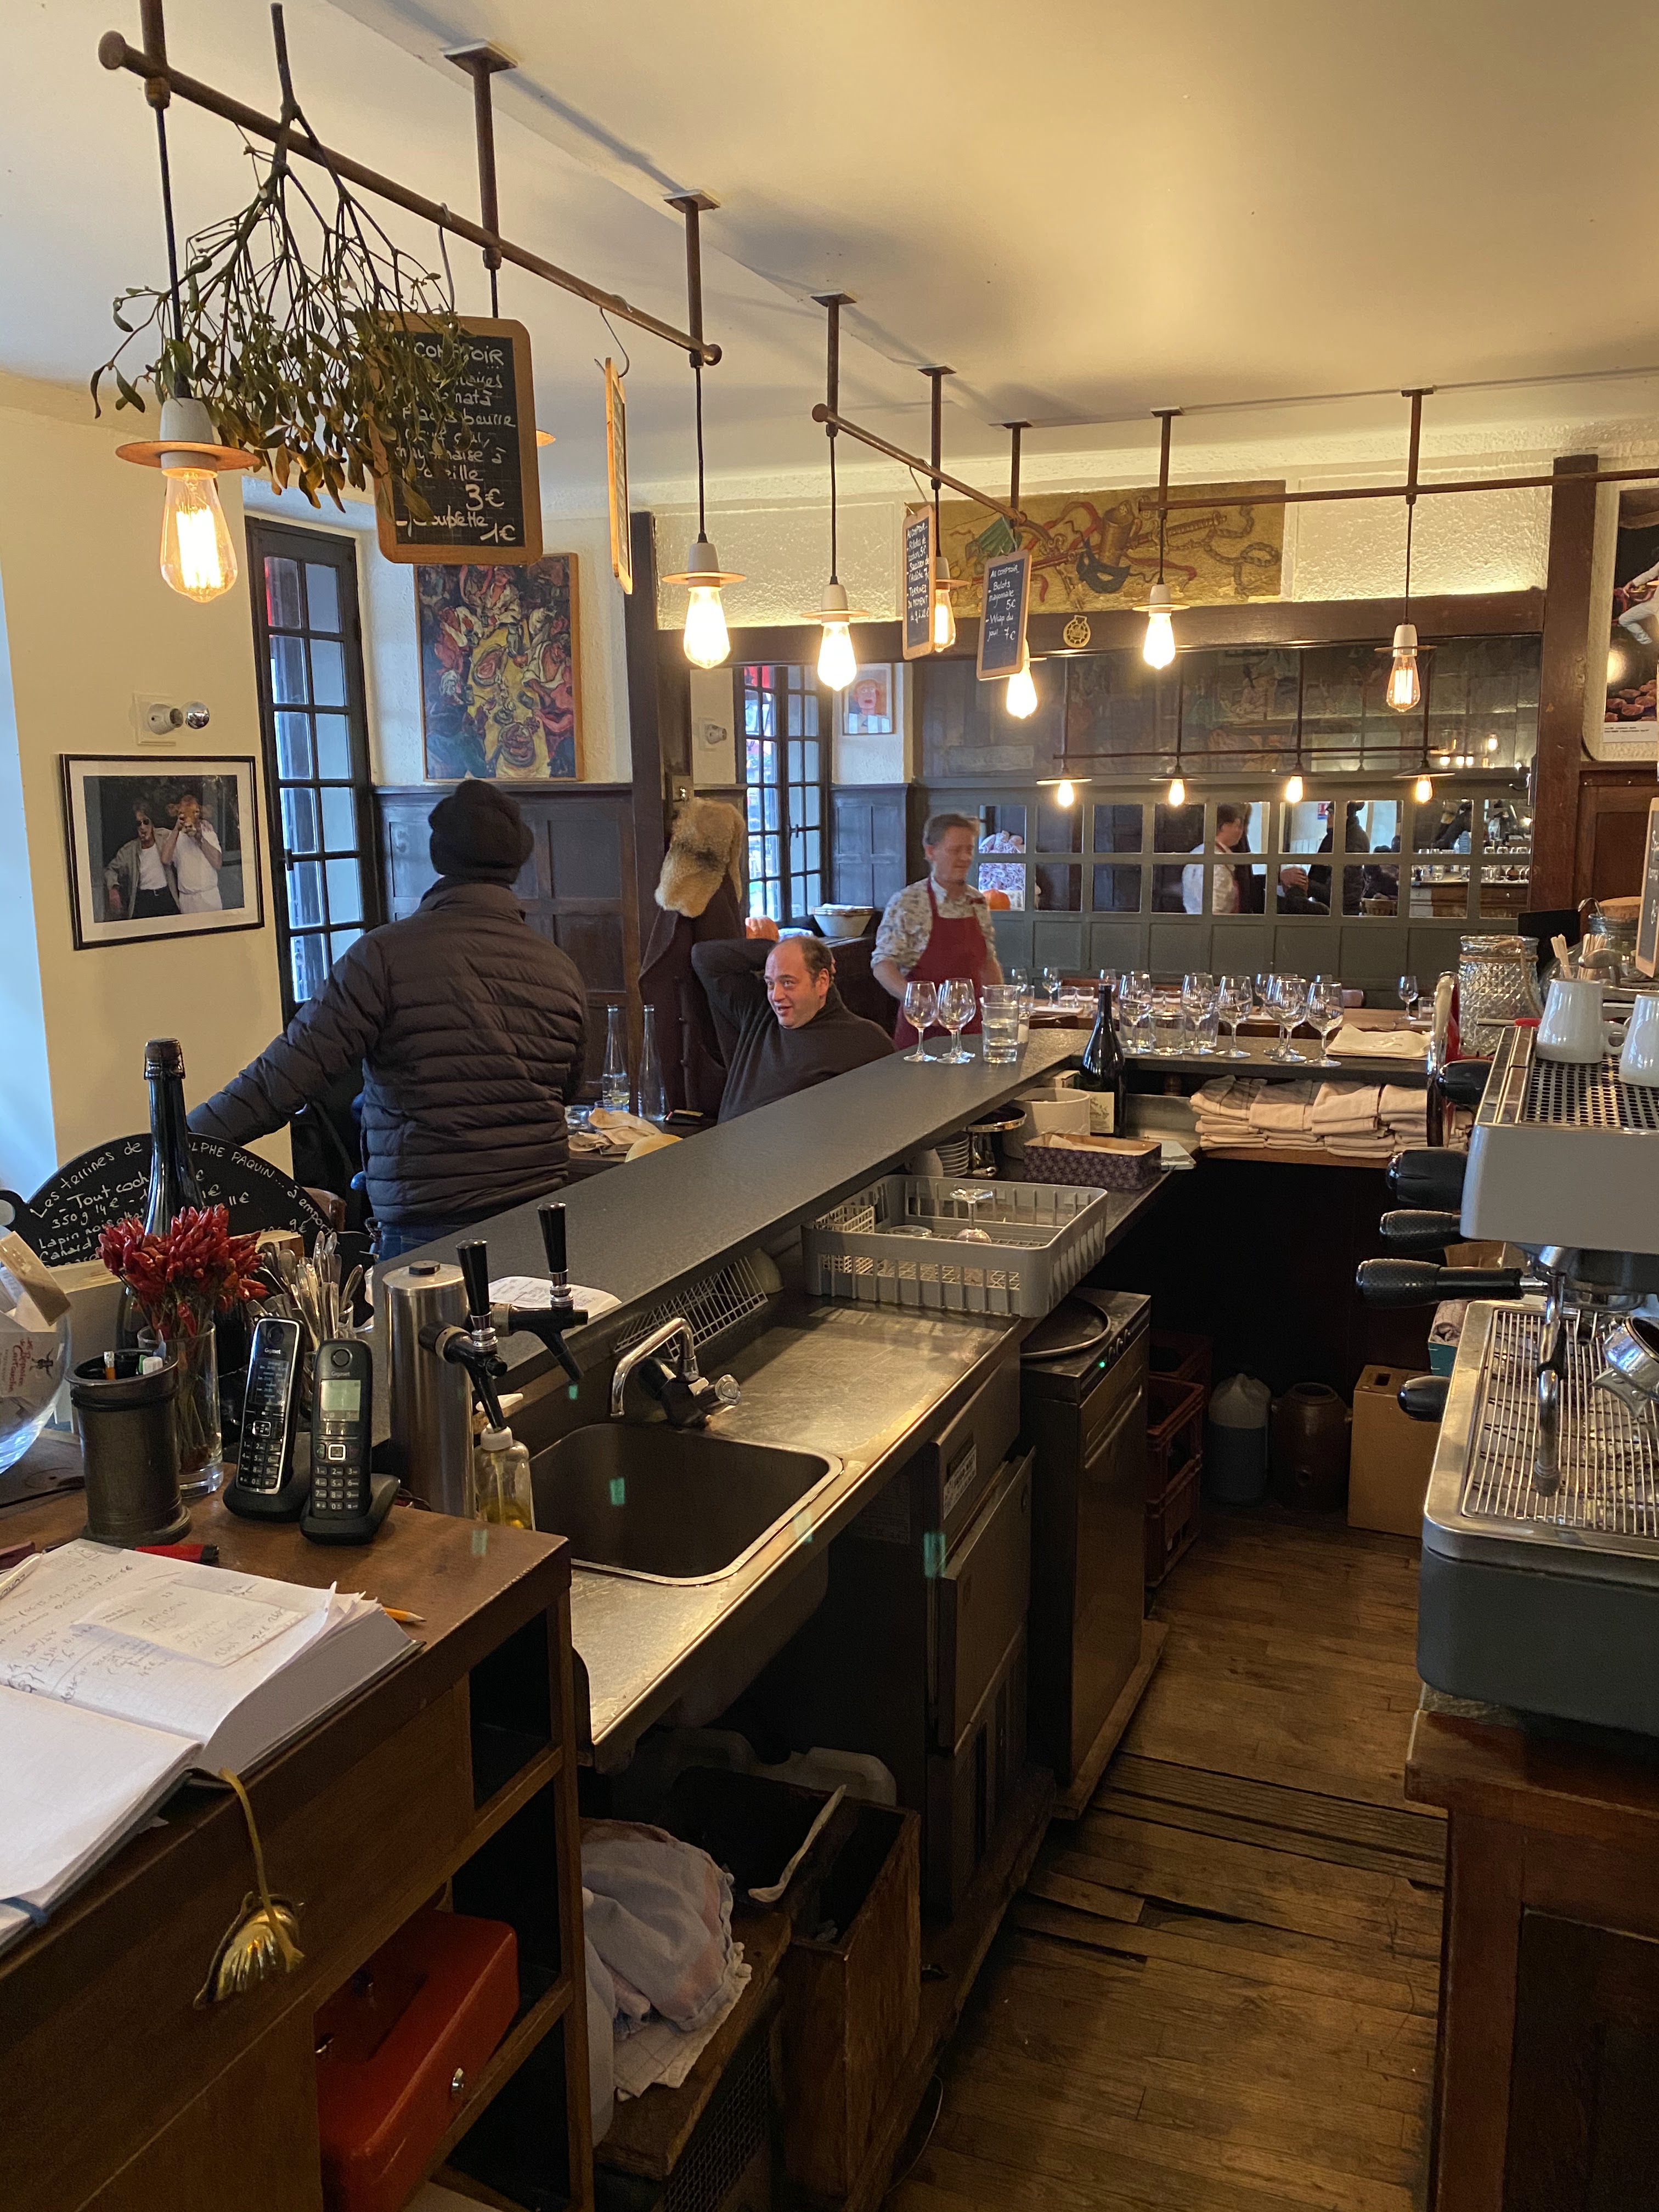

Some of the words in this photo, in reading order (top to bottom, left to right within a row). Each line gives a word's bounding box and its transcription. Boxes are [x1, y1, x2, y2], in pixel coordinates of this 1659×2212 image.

[465, 483, 505, 511] 3€
[479, 522, 517, 543] 1€
[1006, 599, 1016, 611] 5€
[30, 1190, 60, 1218] Les
[123, 1141, 143, 1156] de
[66, 1184, 111, 1209] Tout
[38, 1232, 80, 1250] Lapin
